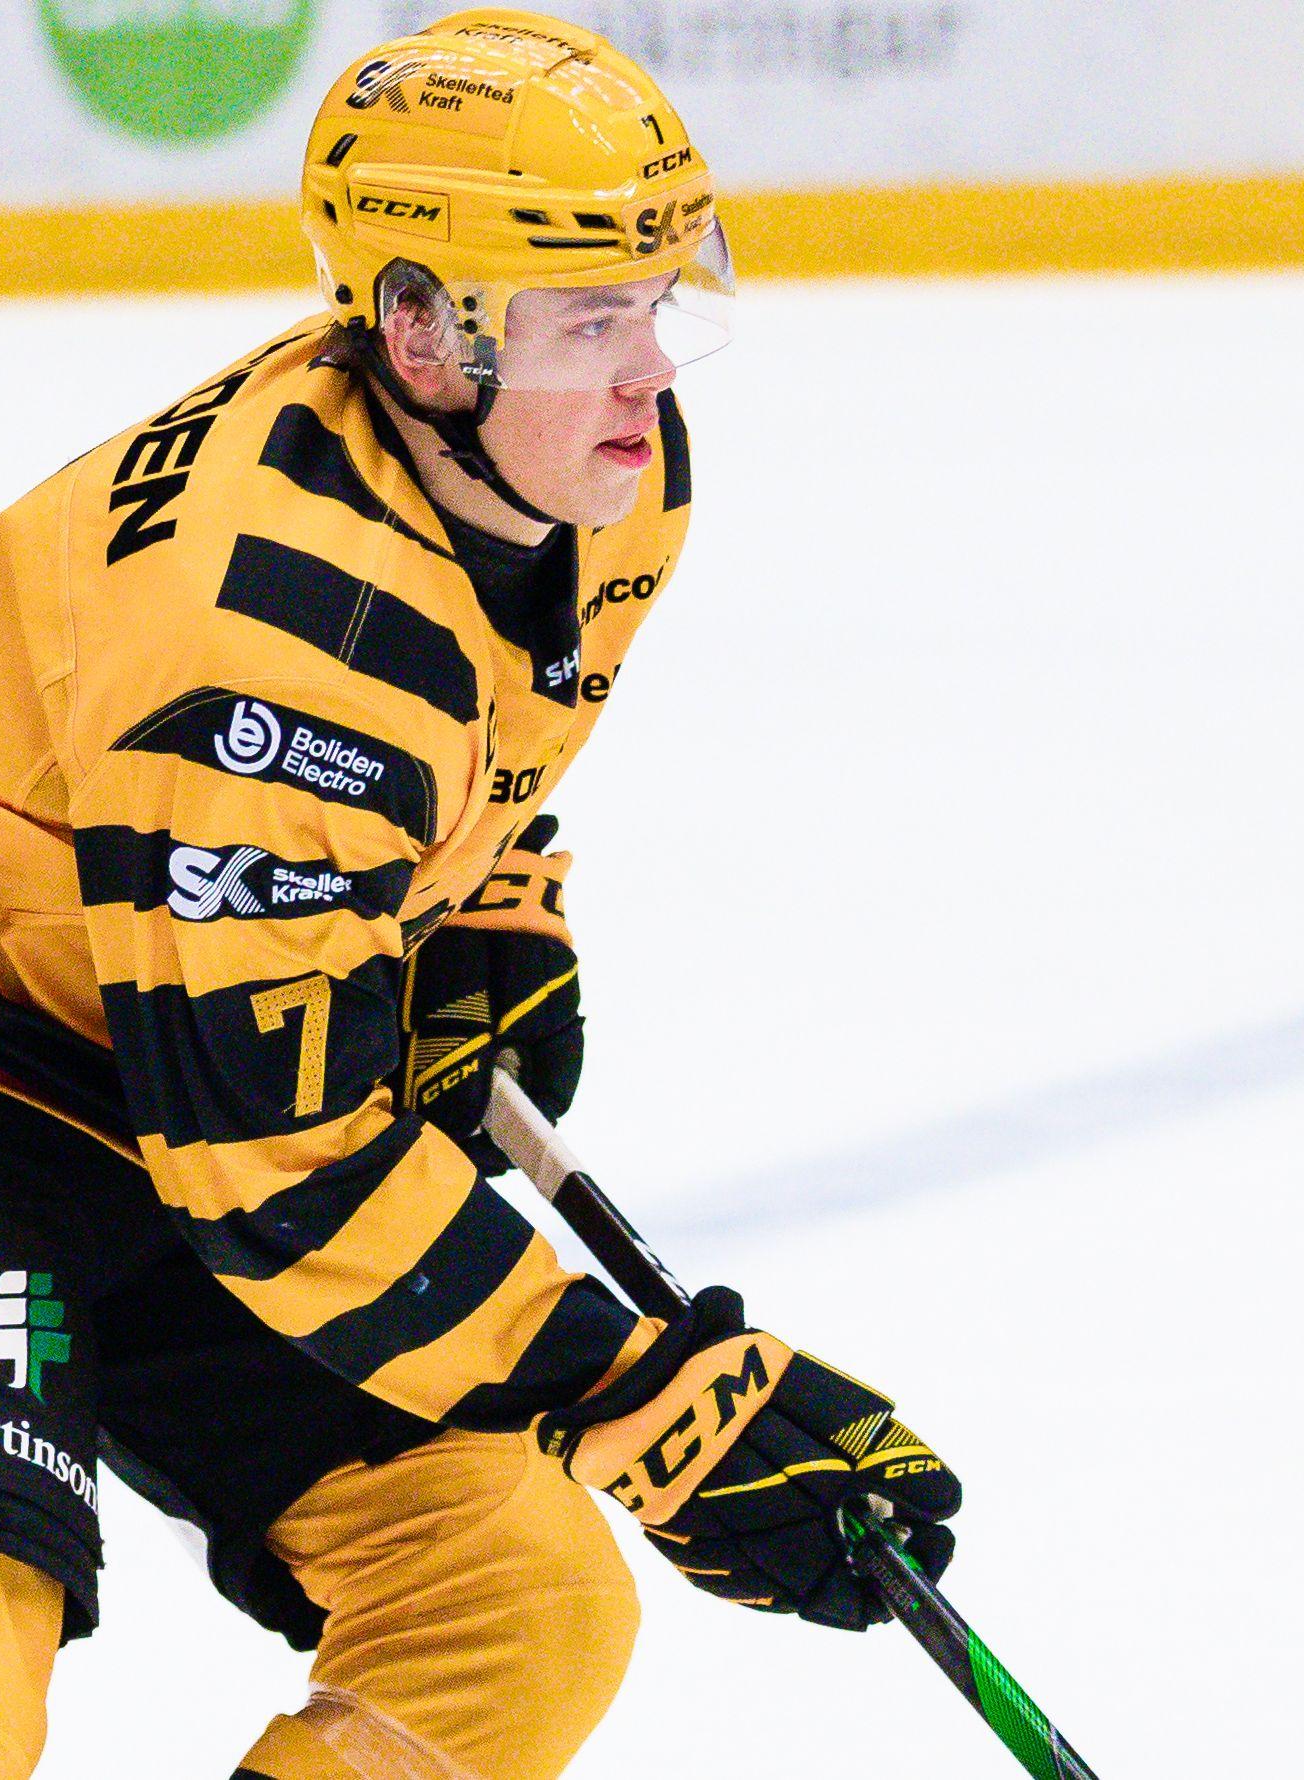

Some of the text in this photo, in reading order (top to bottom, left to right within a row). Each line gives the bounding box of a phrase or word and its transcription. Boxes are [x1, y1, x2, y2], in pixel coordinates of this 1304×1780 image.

[418, 91, 463, 112] Kraft
[426, 73, 514, 104] Skellefteå
[643, 147, 692, 180] CCM
[357, 196, 441, 222] CCM
[291, 727, 385, 781] Boliden
[282, 750, 366, 796] Electro
[250, 974, 331, 1118] 7
[422, 1058, 479, 1104] CCM
[884, 1459, 941, 1479] CCM
